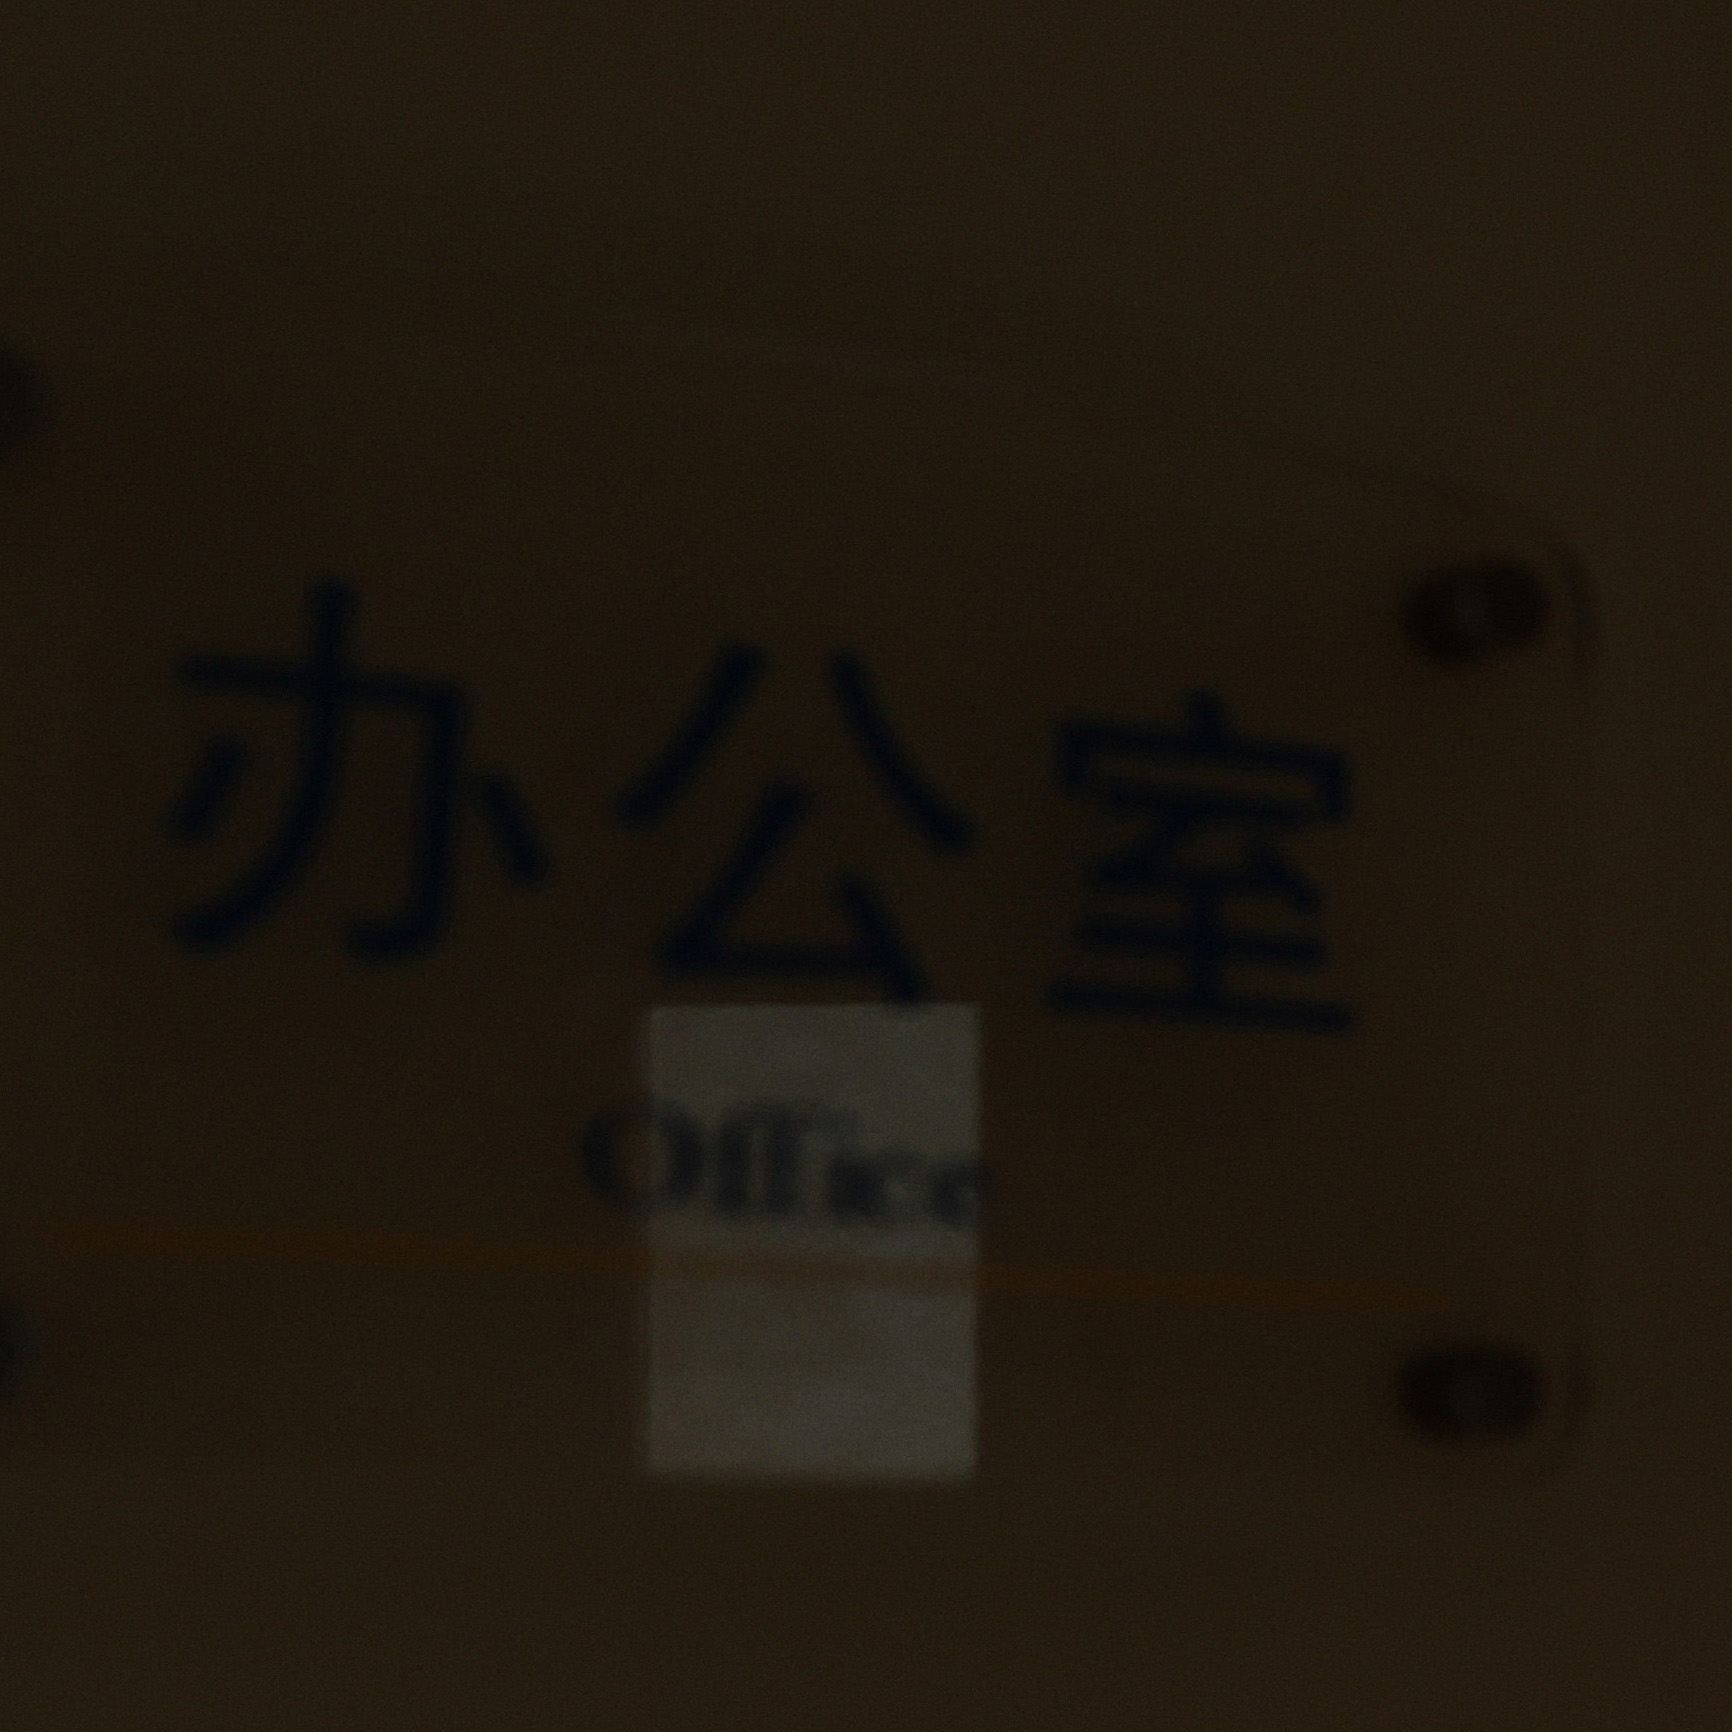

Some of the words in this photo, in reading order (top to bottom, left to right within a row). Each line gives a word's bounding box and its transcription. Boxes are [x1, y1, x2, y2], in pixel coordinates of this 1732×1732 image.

[168, 578, 1356, 1036] 办公室
[574, 1100, 992, 1232] Office
